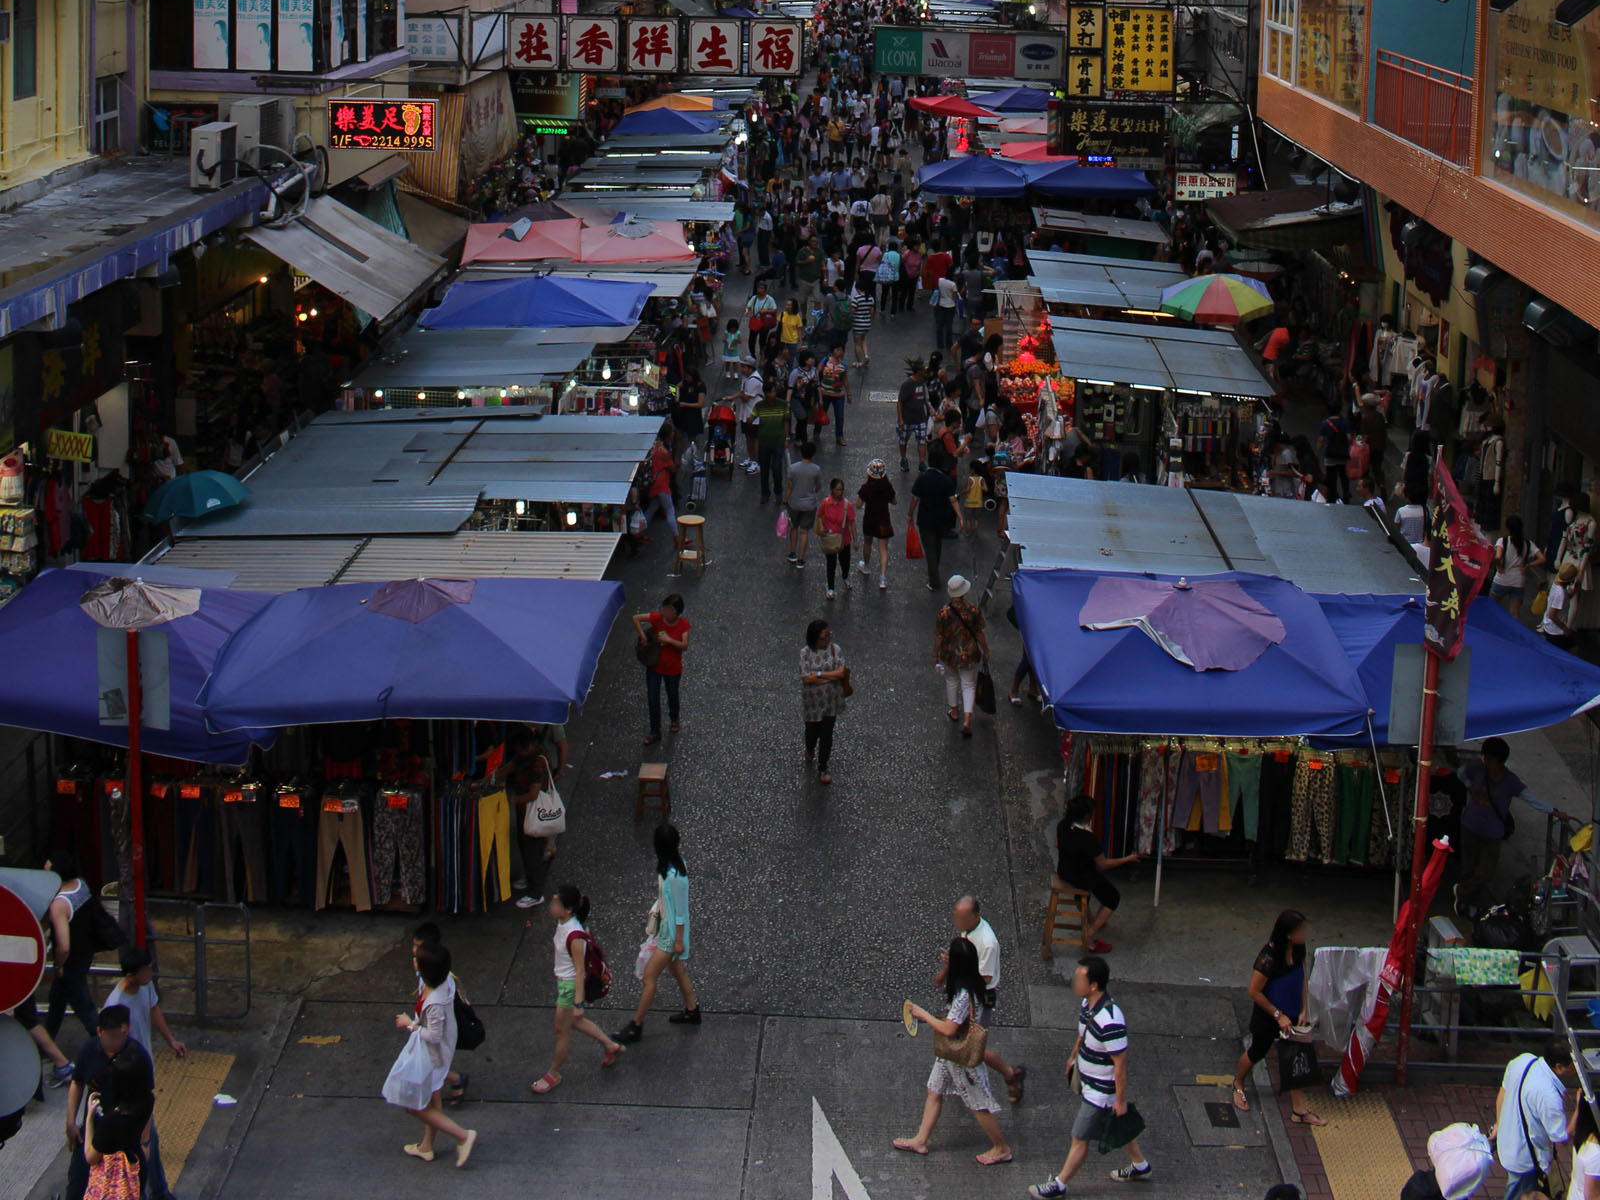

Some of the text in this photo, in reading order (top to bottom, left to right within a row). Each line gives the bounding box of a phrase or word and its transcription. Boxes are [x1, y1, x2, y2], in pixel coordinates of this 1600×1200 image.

[332, 135, 433, 148] 1/F 2214 9995
